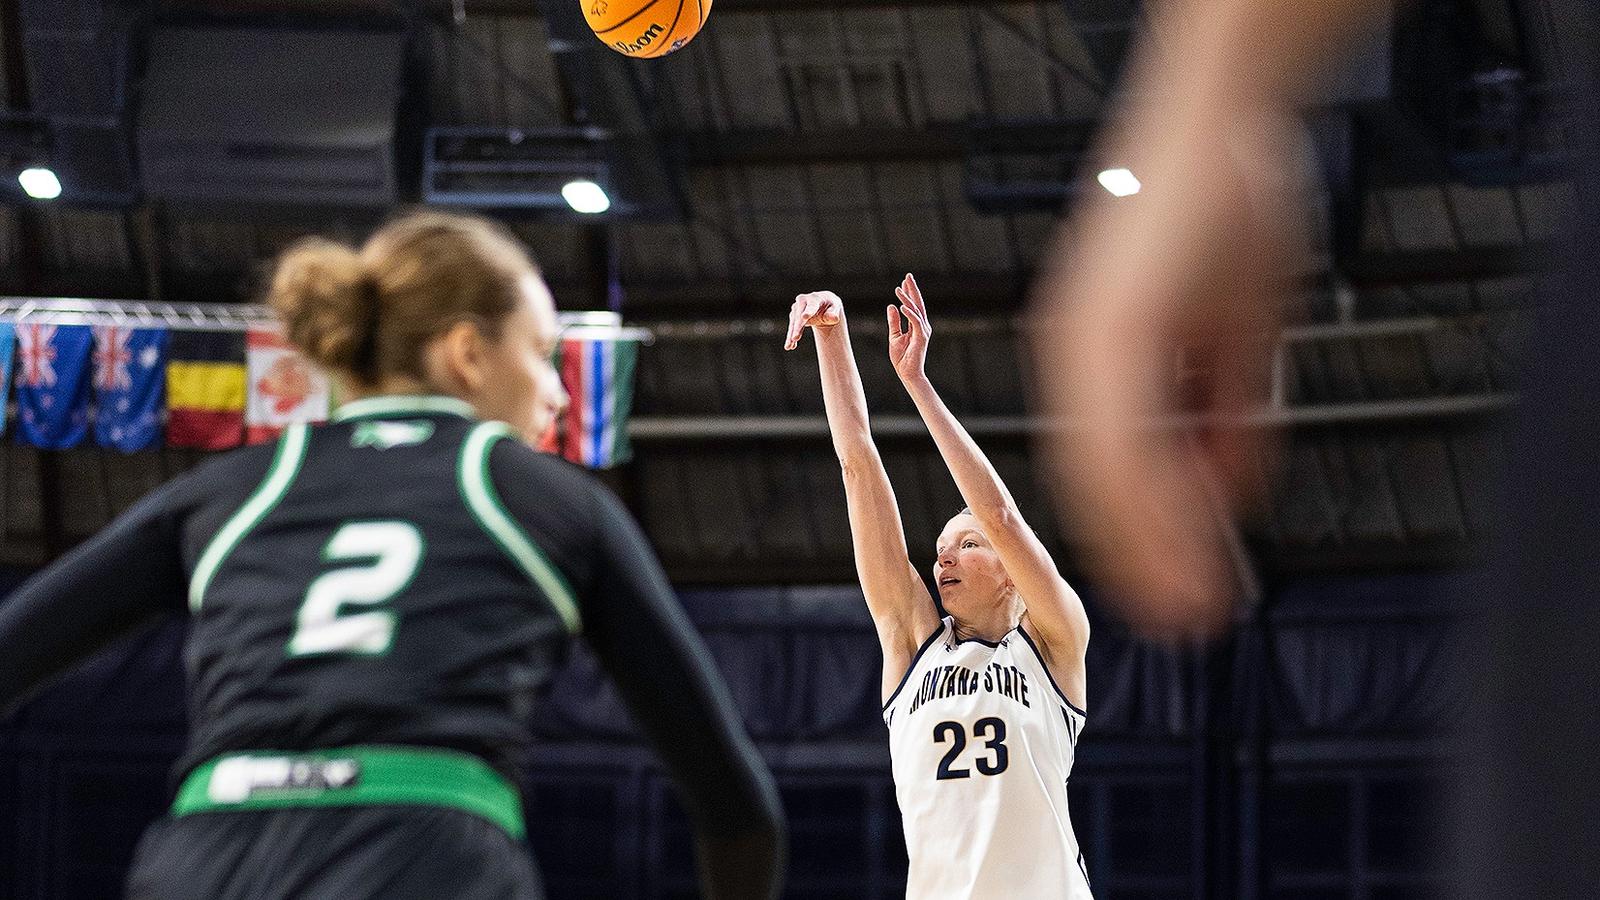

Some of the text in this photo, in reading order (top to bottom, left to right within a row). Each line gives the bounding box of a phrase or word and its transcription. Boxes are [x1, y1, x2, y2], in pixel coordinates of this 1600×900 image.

[612, 23, 664, 53] lson
[287, 520, 426, 657] 2
[984, 662, 1031, 709] STATE
[933, 716, 1009, 780] 23
